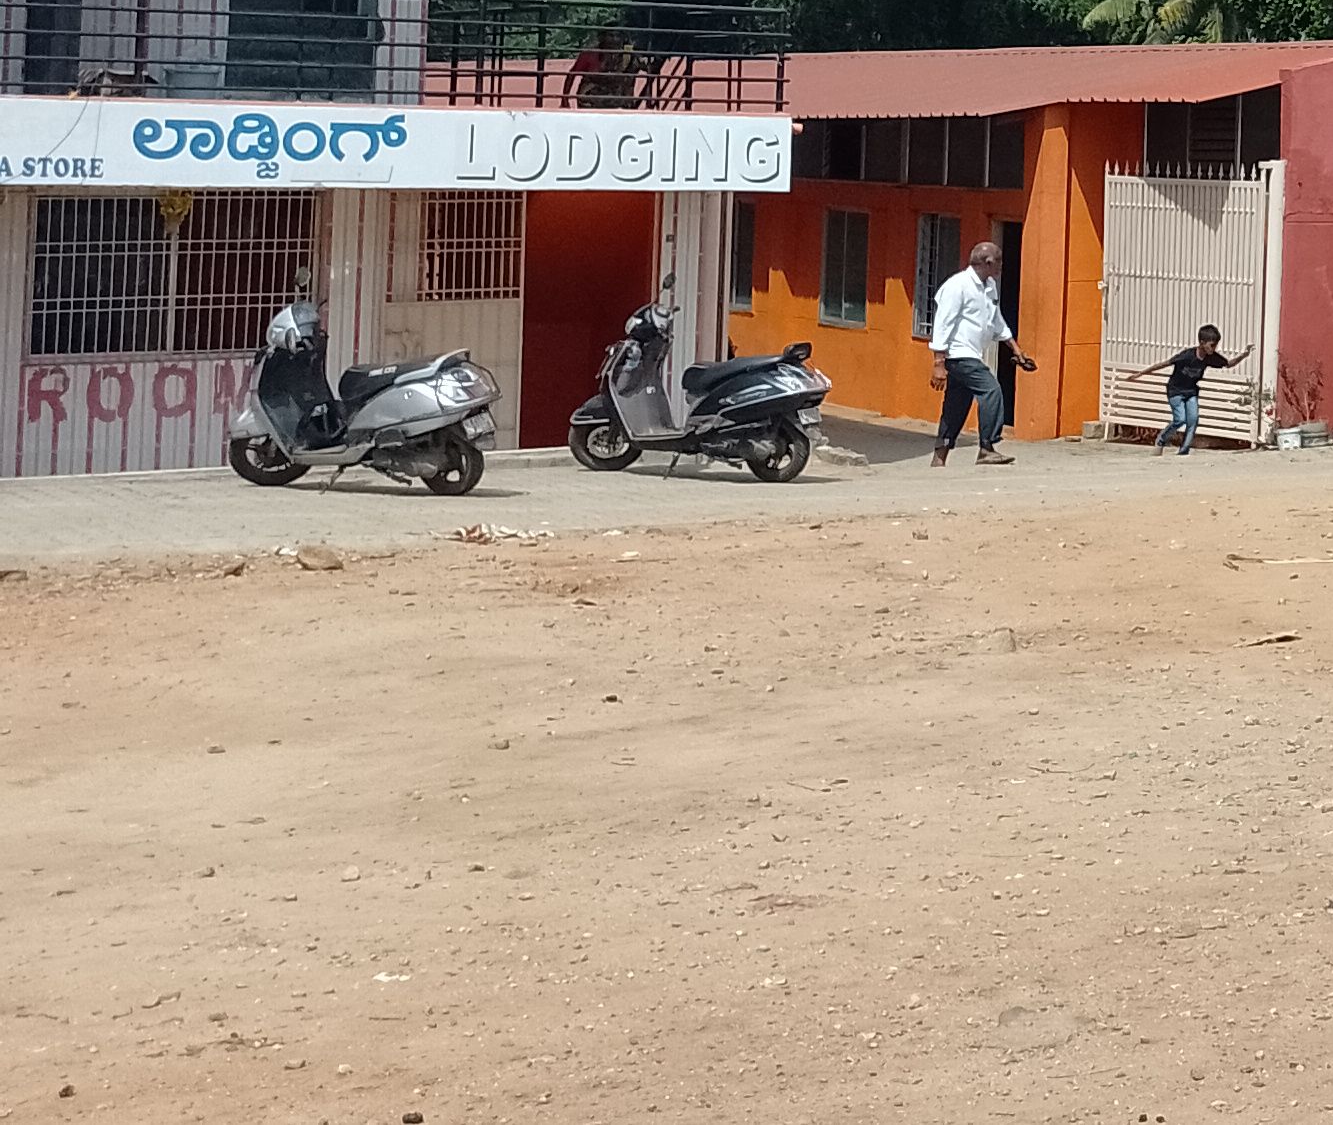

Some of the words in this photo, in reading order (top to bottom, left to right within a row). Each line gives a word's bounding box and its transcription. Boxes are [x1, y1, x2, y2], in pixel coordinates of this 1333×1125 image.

[21, 156, 104, 179] STORE
[132, 112, 409, 181] ಲಾಡ್ಜಿಂಗ್
[455, 121, 781, 184] LODGING
